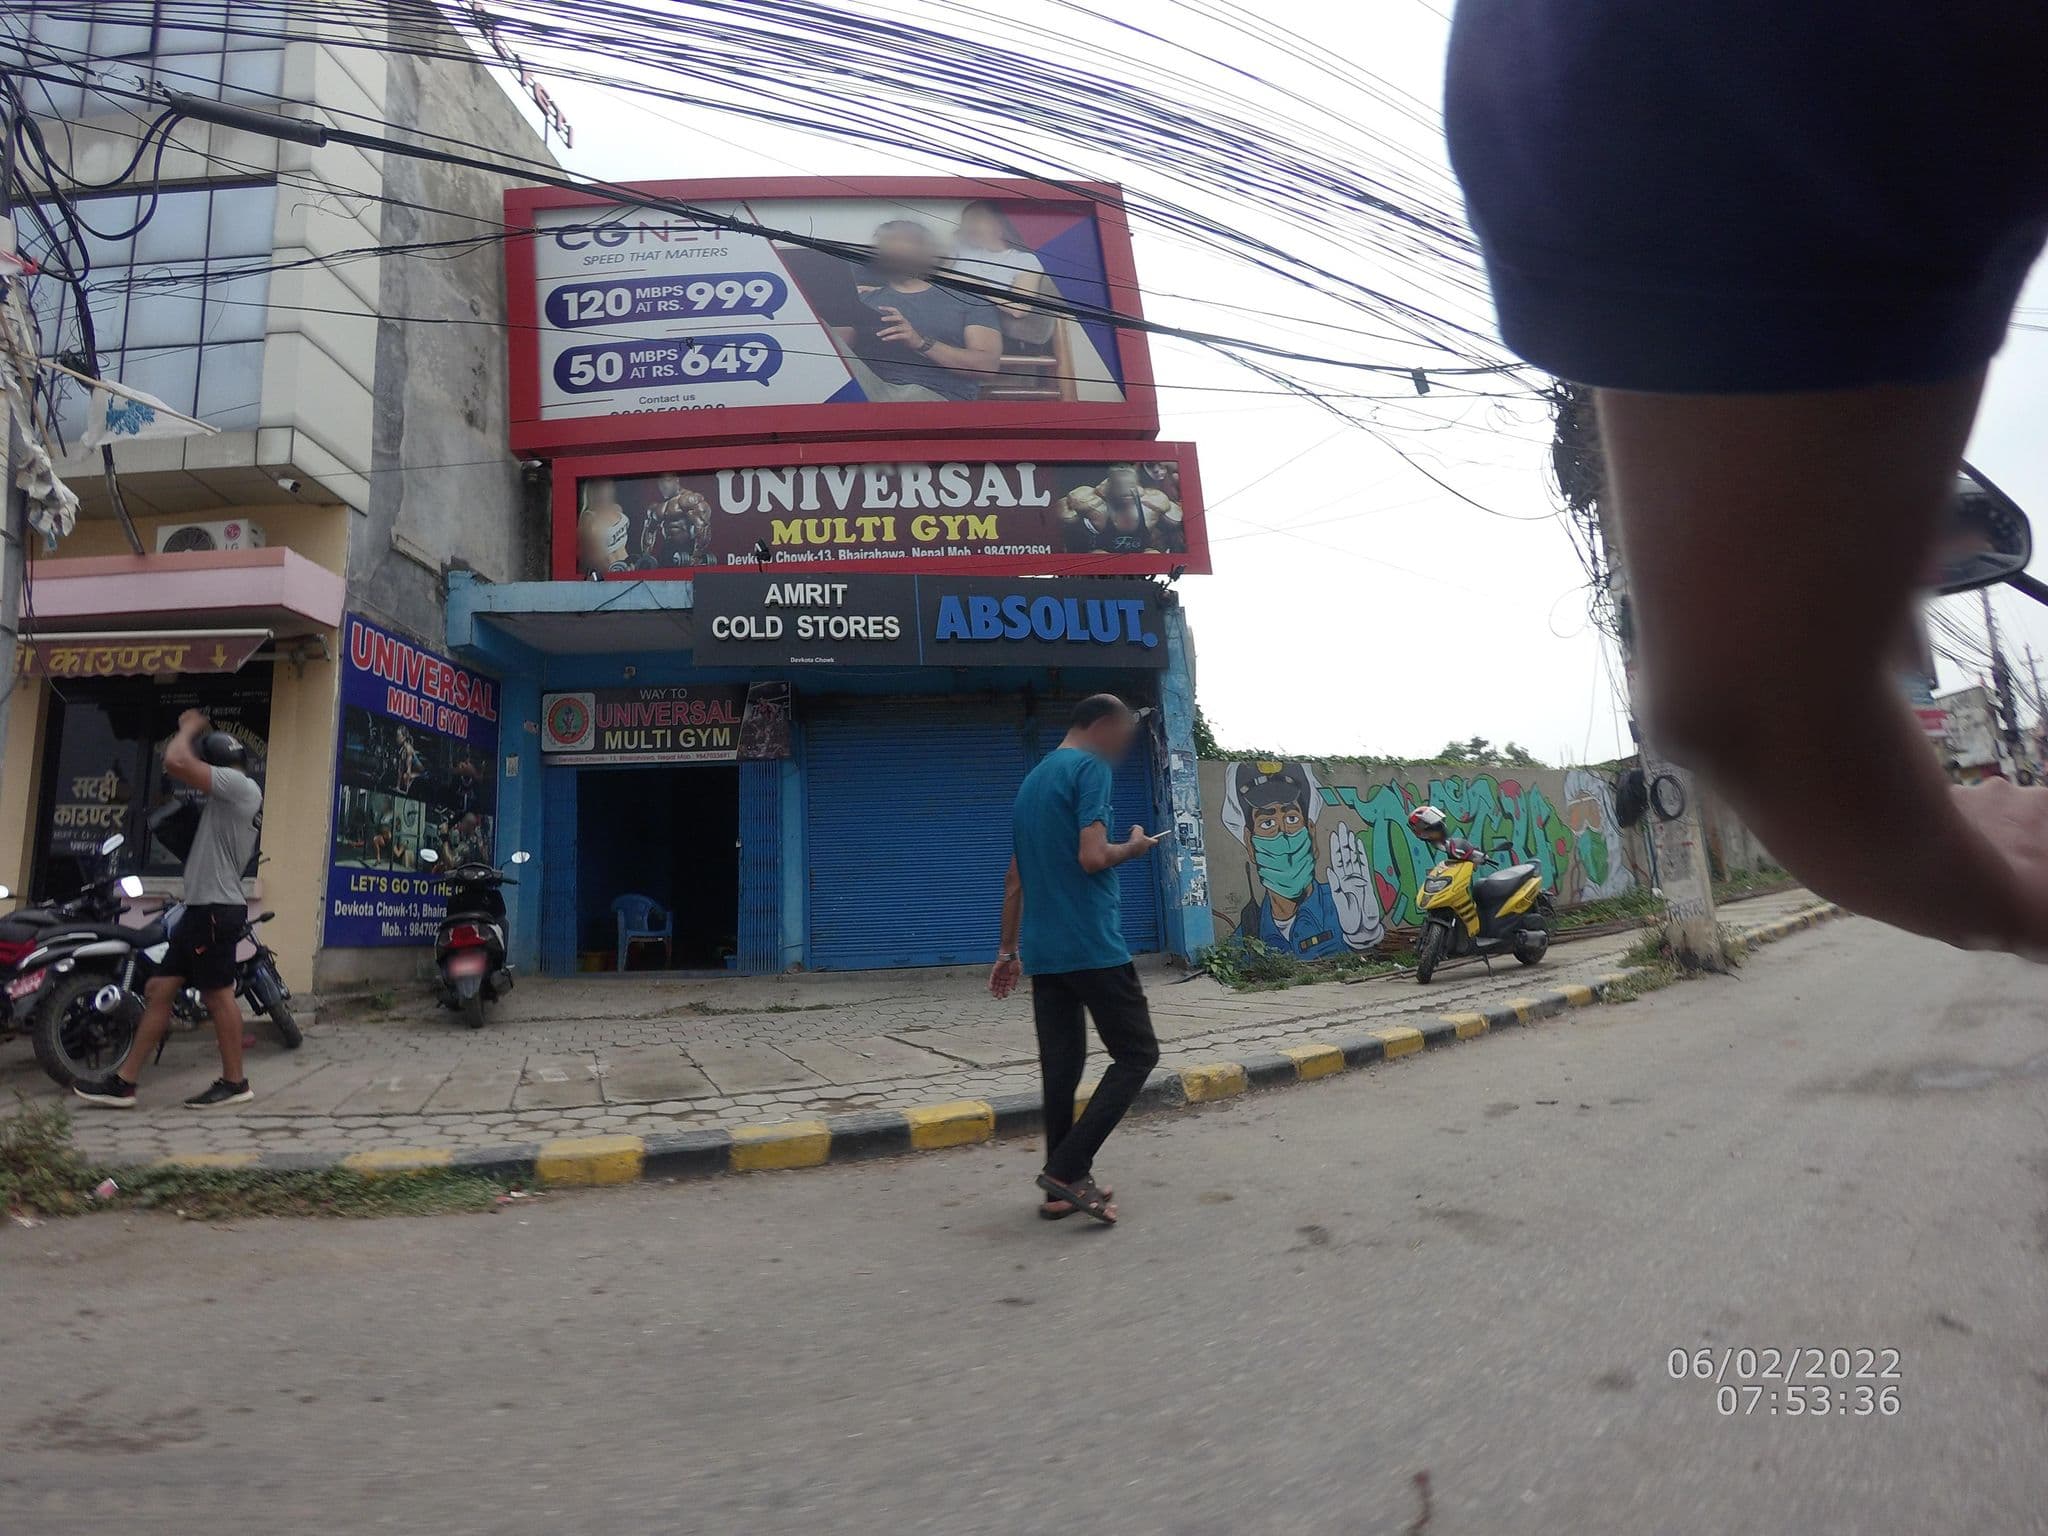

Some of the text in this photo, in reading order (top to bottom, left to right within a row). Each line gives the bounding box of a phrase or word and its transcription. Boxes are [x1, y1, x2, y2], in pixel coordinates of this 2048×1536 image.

[584, 247, 728, 266] SPEED THAT MATTERS
[562, 279, 774, 321] 120 MBPS 999
[635, 300, 684, 314] AT RS.
[568, 341, 769, 386] 50 MBPS 649
[630, 365, 678, 379] AT RS.
[638, 393, 696, 405] Contact us
[715, 462, 1051, 514] UNIVERSAL
[770, 514, 1000, 545] MULTI GYM
[727, 552, 774, 566] Devk
[764, 583, 848, 606] AMRIT
[712, 615, 901, 640] COLD STORES
[936, 595, 1158, 649] ABSOLUT.
[351, 621, 497, 722] UNIVERSAL
[639, 688, 688, 700] WAY TO
[387, 686, 468, 739] MULTI GYM
[596, 700, 741, 728] UNIVERSAL
[605, 727, 731, 750] MULTI GYM
[350, 874, 387, 893] LET'S
[391, 878, 410, 894] GO
[413, 879, 429, 895] TO
[334, 900, 447, 919] Devkota Chowk-13, Bhaira
[381, 922, 402, 937] Mob.
[409, 921, 442, 937] 984702
